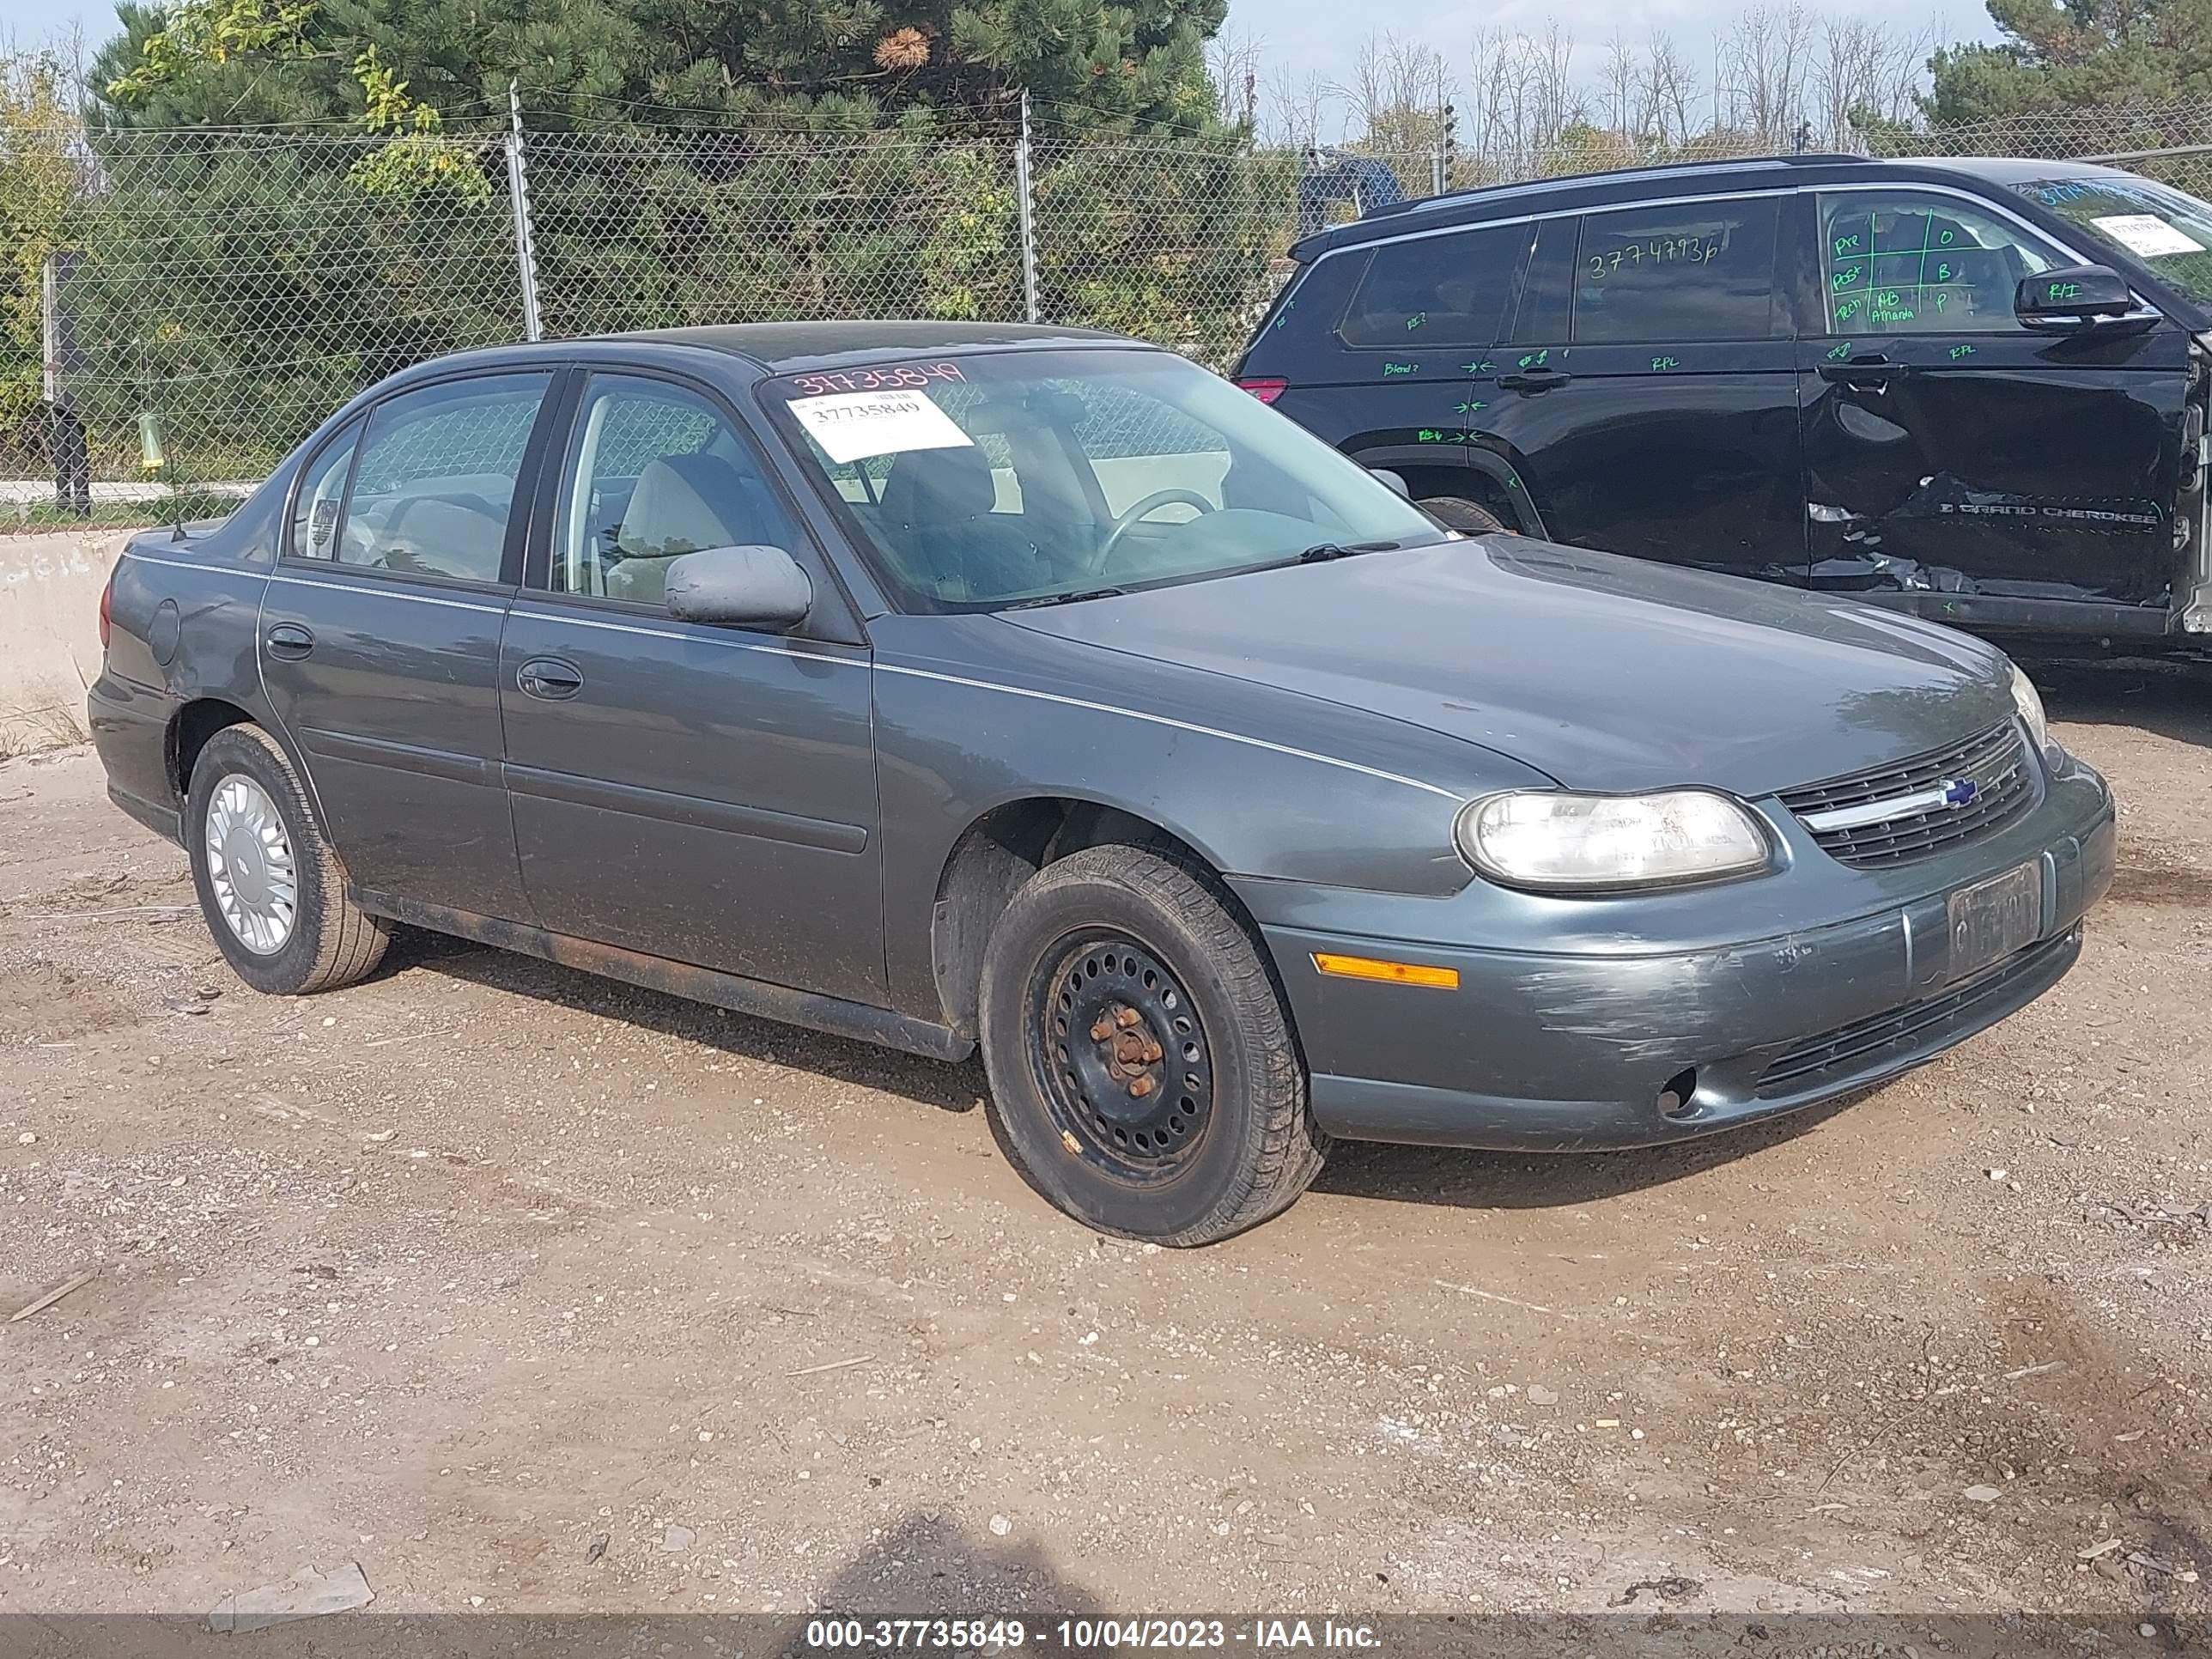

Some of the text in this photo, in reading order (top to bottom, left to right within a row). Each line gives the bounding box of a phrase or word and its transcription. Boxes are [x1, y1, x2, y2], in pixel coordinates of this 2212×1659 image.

[1589, 237, 1718, 279] 37747936
[793, 362, 968, 395] 37735849
[1959, 504, 2036, 515] GRAND
[2043, 507, 2157, 524] CHEROKEE
